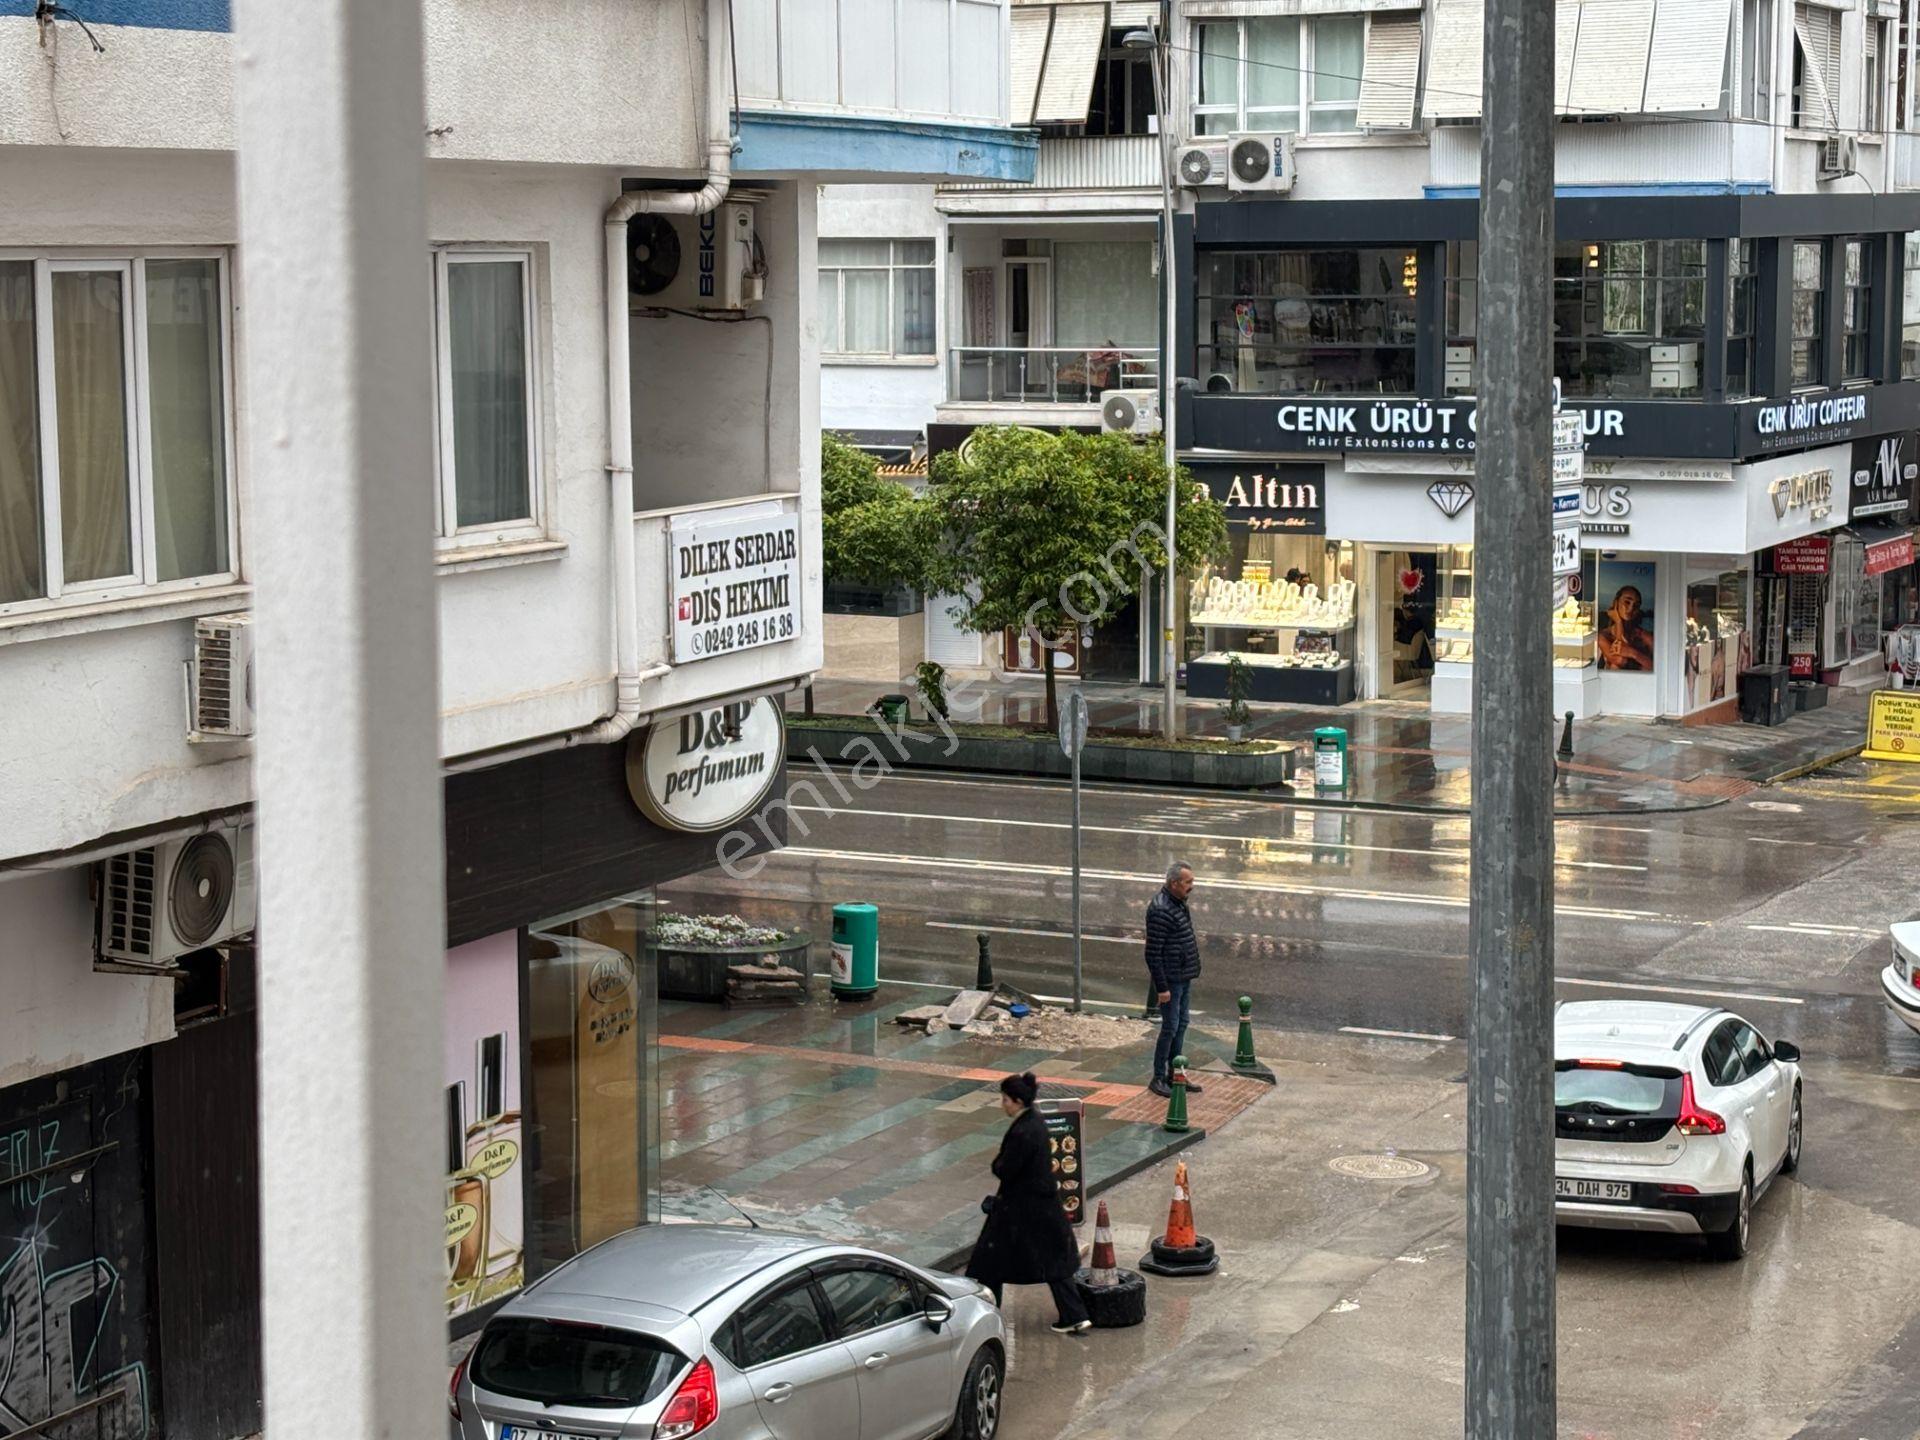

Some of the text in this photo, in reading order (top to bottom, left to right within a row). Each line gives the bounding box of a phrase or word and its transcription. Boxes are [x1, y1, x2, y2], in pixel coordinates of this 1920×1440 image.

[1274, 137, 1283, 177] BEKO
[1277, 405, 1357, 433] CENK
[1370, 401, 1457, 434] ÜRÜT
[1758, 395, 1866, 434] CENK ÜRÜT COIFFEUR
[1307, 436, 1340, 448] Hair
[1345, 436, 1435, 449] Extensions
[1440, 438, 1450, 449] &
[1224, 474, 1319, 508] Altın
[680, 528, 797, 579] DİLEK SERDAR
[725, 562, 790, 619] HEKİMİ
[704, 613, 793, 654] 0242 248 16 38
[1794, 656, 1811, 668] 250
[1904, 701, 1920, 709] TAKS
[677, 700, 752, 755] D&P
[663, 752, 765, 805] perfumum
[1568, 1117, 1636, 1127] OLVO
[483, 1143, 506, 1162] D&P
[1556, 1180, 1629, 1198] 34 DAH 975
